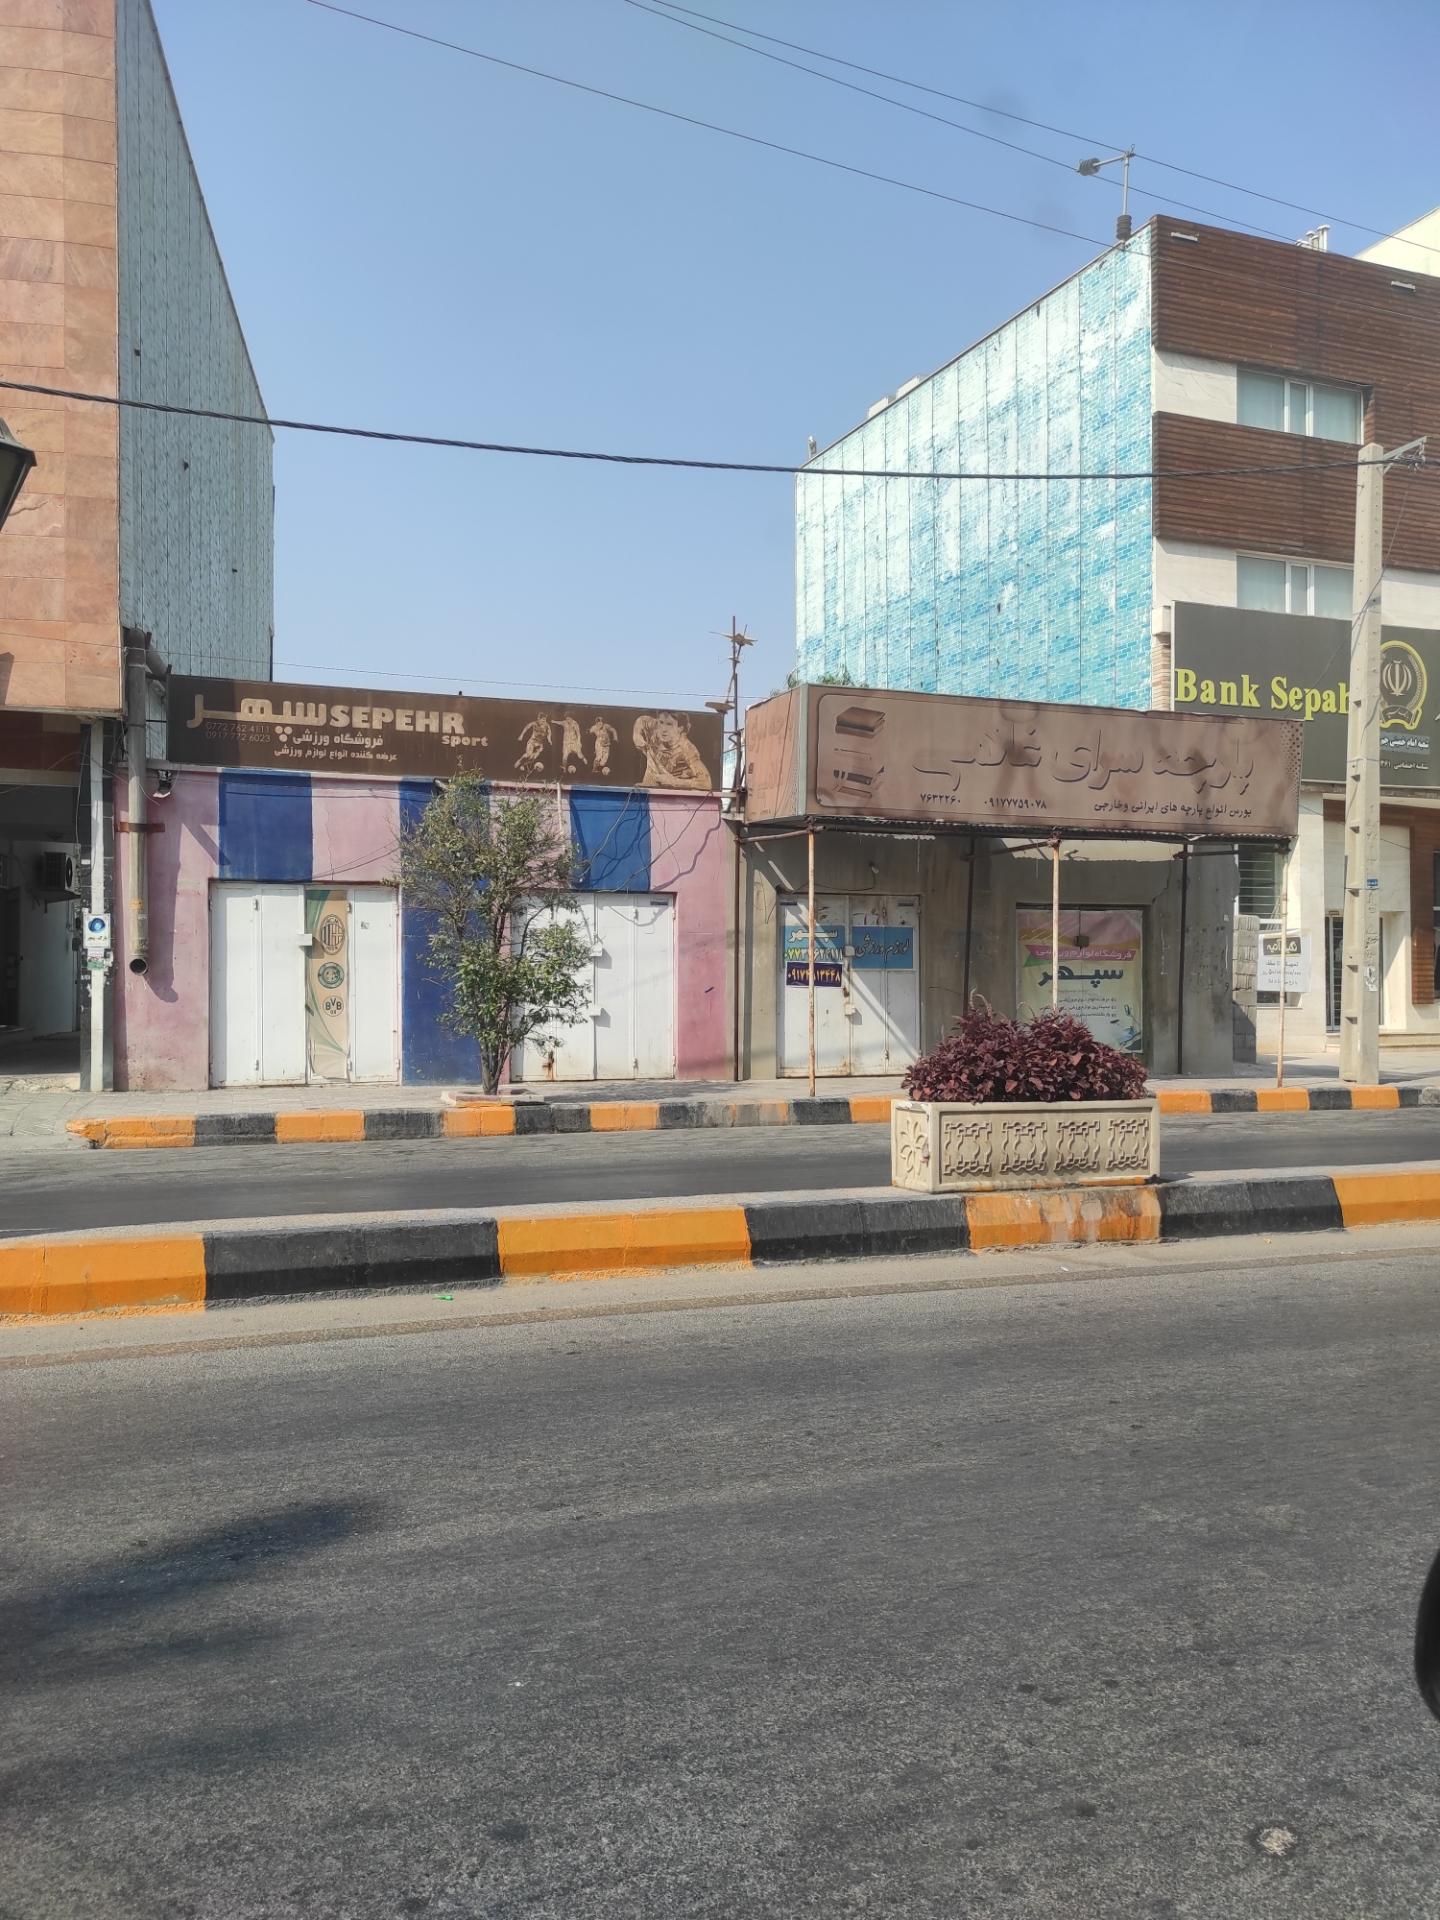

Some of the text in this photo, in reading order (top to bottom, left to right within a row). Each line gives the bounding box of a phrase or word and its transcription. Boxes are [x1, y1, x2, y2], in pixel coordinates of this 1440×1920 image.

[1174, 668, 1261, 709] Bank
[329, 705, 465, 735] SEPEHR
[293, 728, 384, 748] فروشگاه ورزشی
[441, 734, 489, 747] sport
[273, 744, 303, 757] ورزشی
